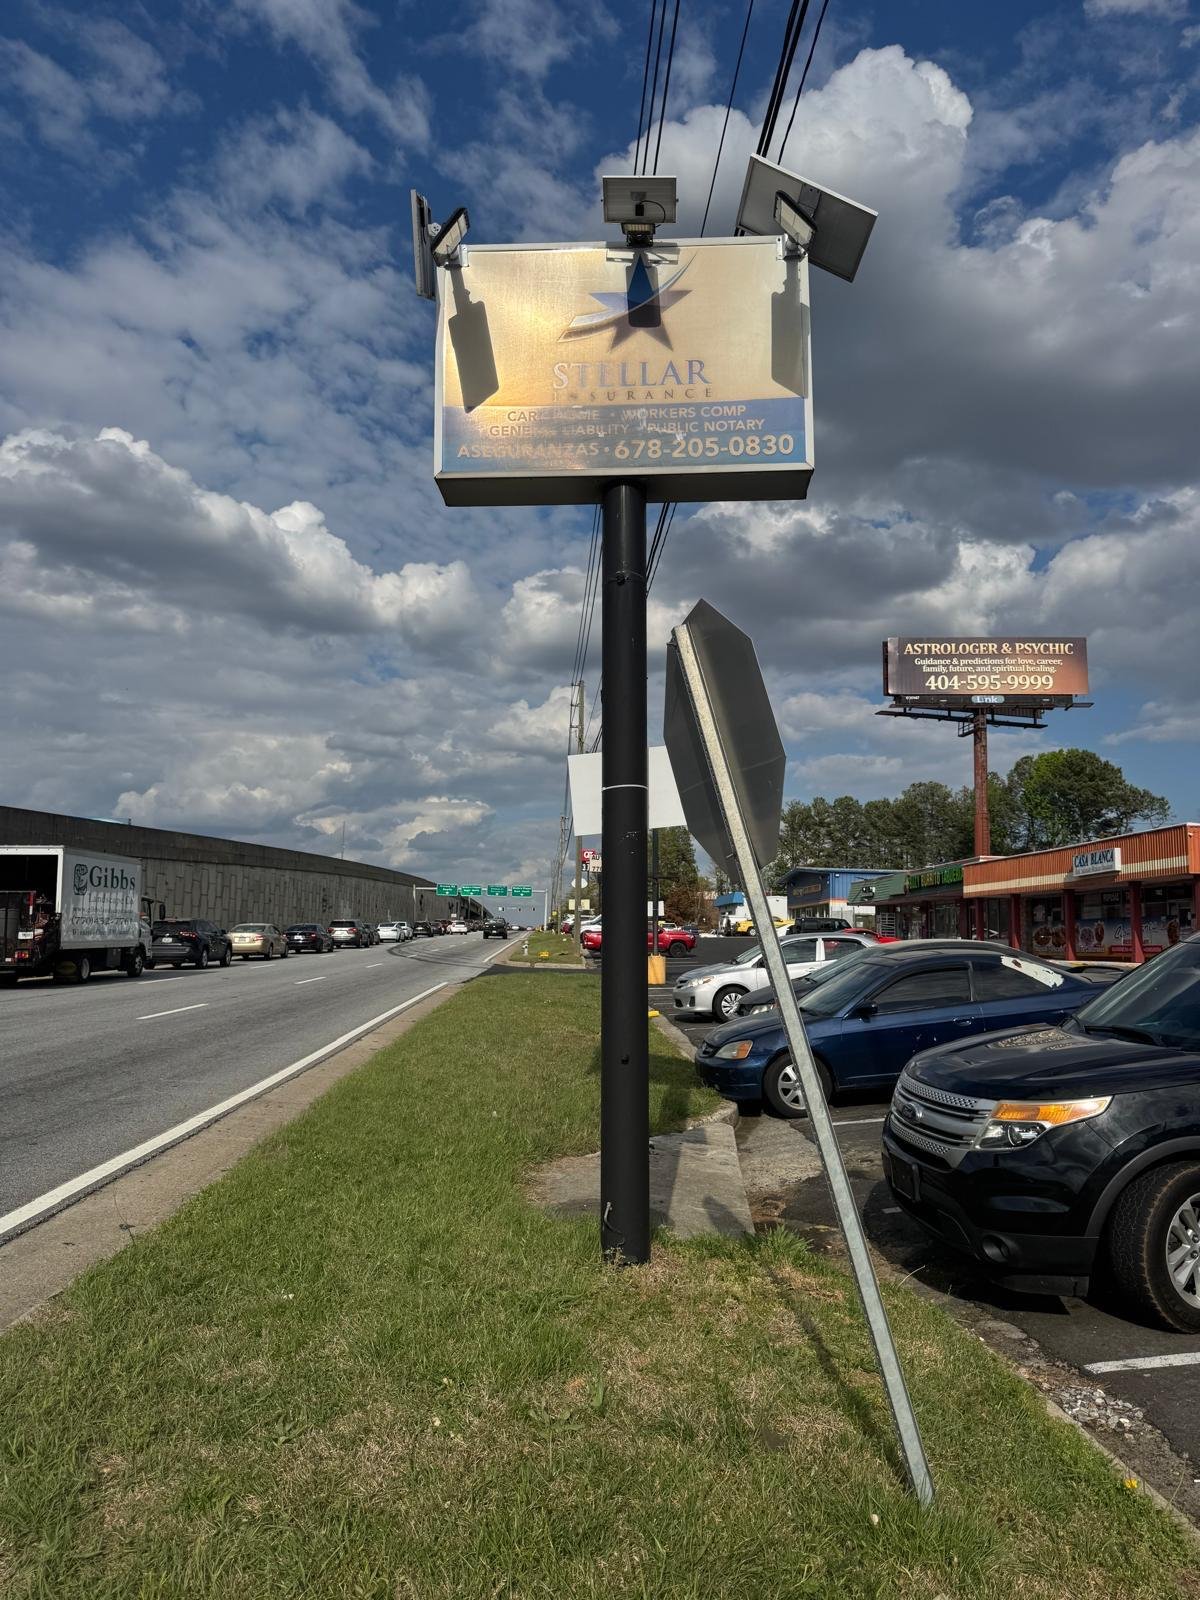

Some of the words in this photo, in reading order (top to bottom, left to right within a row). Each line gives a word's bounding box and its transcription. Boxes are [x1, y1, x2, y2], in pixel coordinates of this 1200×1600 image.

[552, 358, 711, 389] STELLAR
[552, 387, 713, 403] INSURANCE
[506, 410, 537, 422] CAR
[622, 406, 696, 421] WORKERS
[700, 405, 747, 417] COMP
[646, 421, 698, 434] PUBLIC
[703, 419, 765, 432] NOTARY
[456, 442, 600, 459] ASEGURANZAS
[613, 433, 795, 460] 678-205-0830
[904, 642, 998, 656] ASTROLOGER
[1001, 642, 1012, 655] &
[1015, 642, 1074, 655] PSYCHIC
[914, 657, 951, 665] Guidance
[960, 657, 1004, 667] predictions
[1005, 657, 1017, 665] for
[991, 665, 1025, 673] spiritual
[925, 675, 1054, 690] 404-595-9999
[1074, 854, 1089, 868] CASA
[1090, 849, 1114, 865] BLANCA
[89, 866, 136, 891] Gibbs
